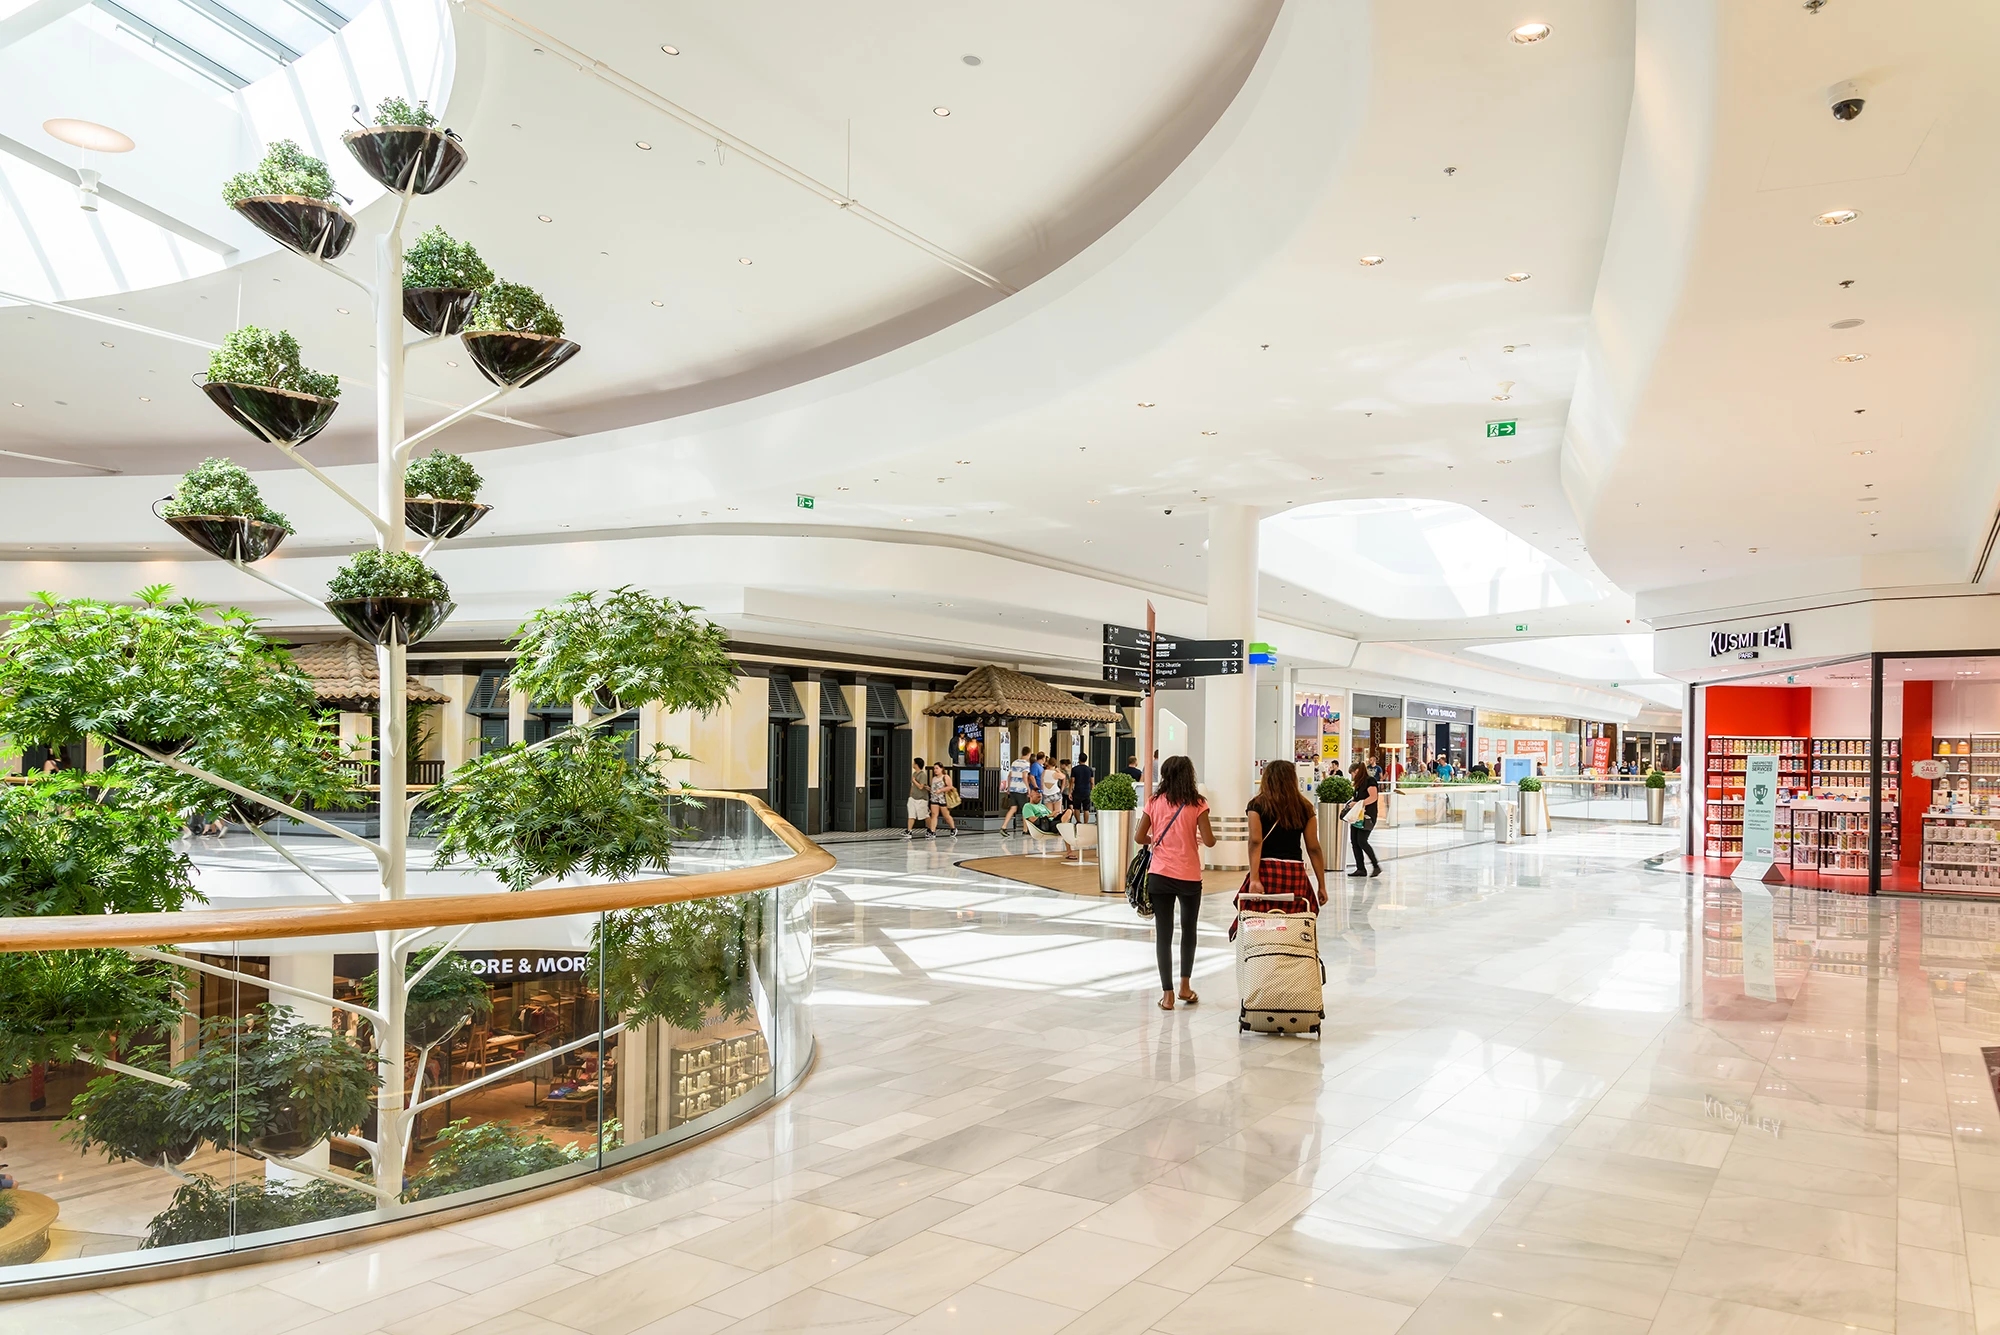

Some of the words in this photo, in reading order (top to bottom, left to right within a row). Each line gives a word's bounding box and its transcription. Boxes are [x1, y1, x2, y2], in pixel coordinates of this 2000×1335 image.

[1709, 631, 1755, 657] KUSMI
[1759, 623, 1789, 649] TEA
[1738, 652, 1755, 660] PARIS
[1301, 698, 1330, 719] claire's
[1426, 707, 1439, 716] TOM
[1440, 709, 1457, 718] TAILOR
[1324, 744, 1329, 752] 3
[1333, 744, 1339, 752] 2
[518, 958, 532, 973] &
